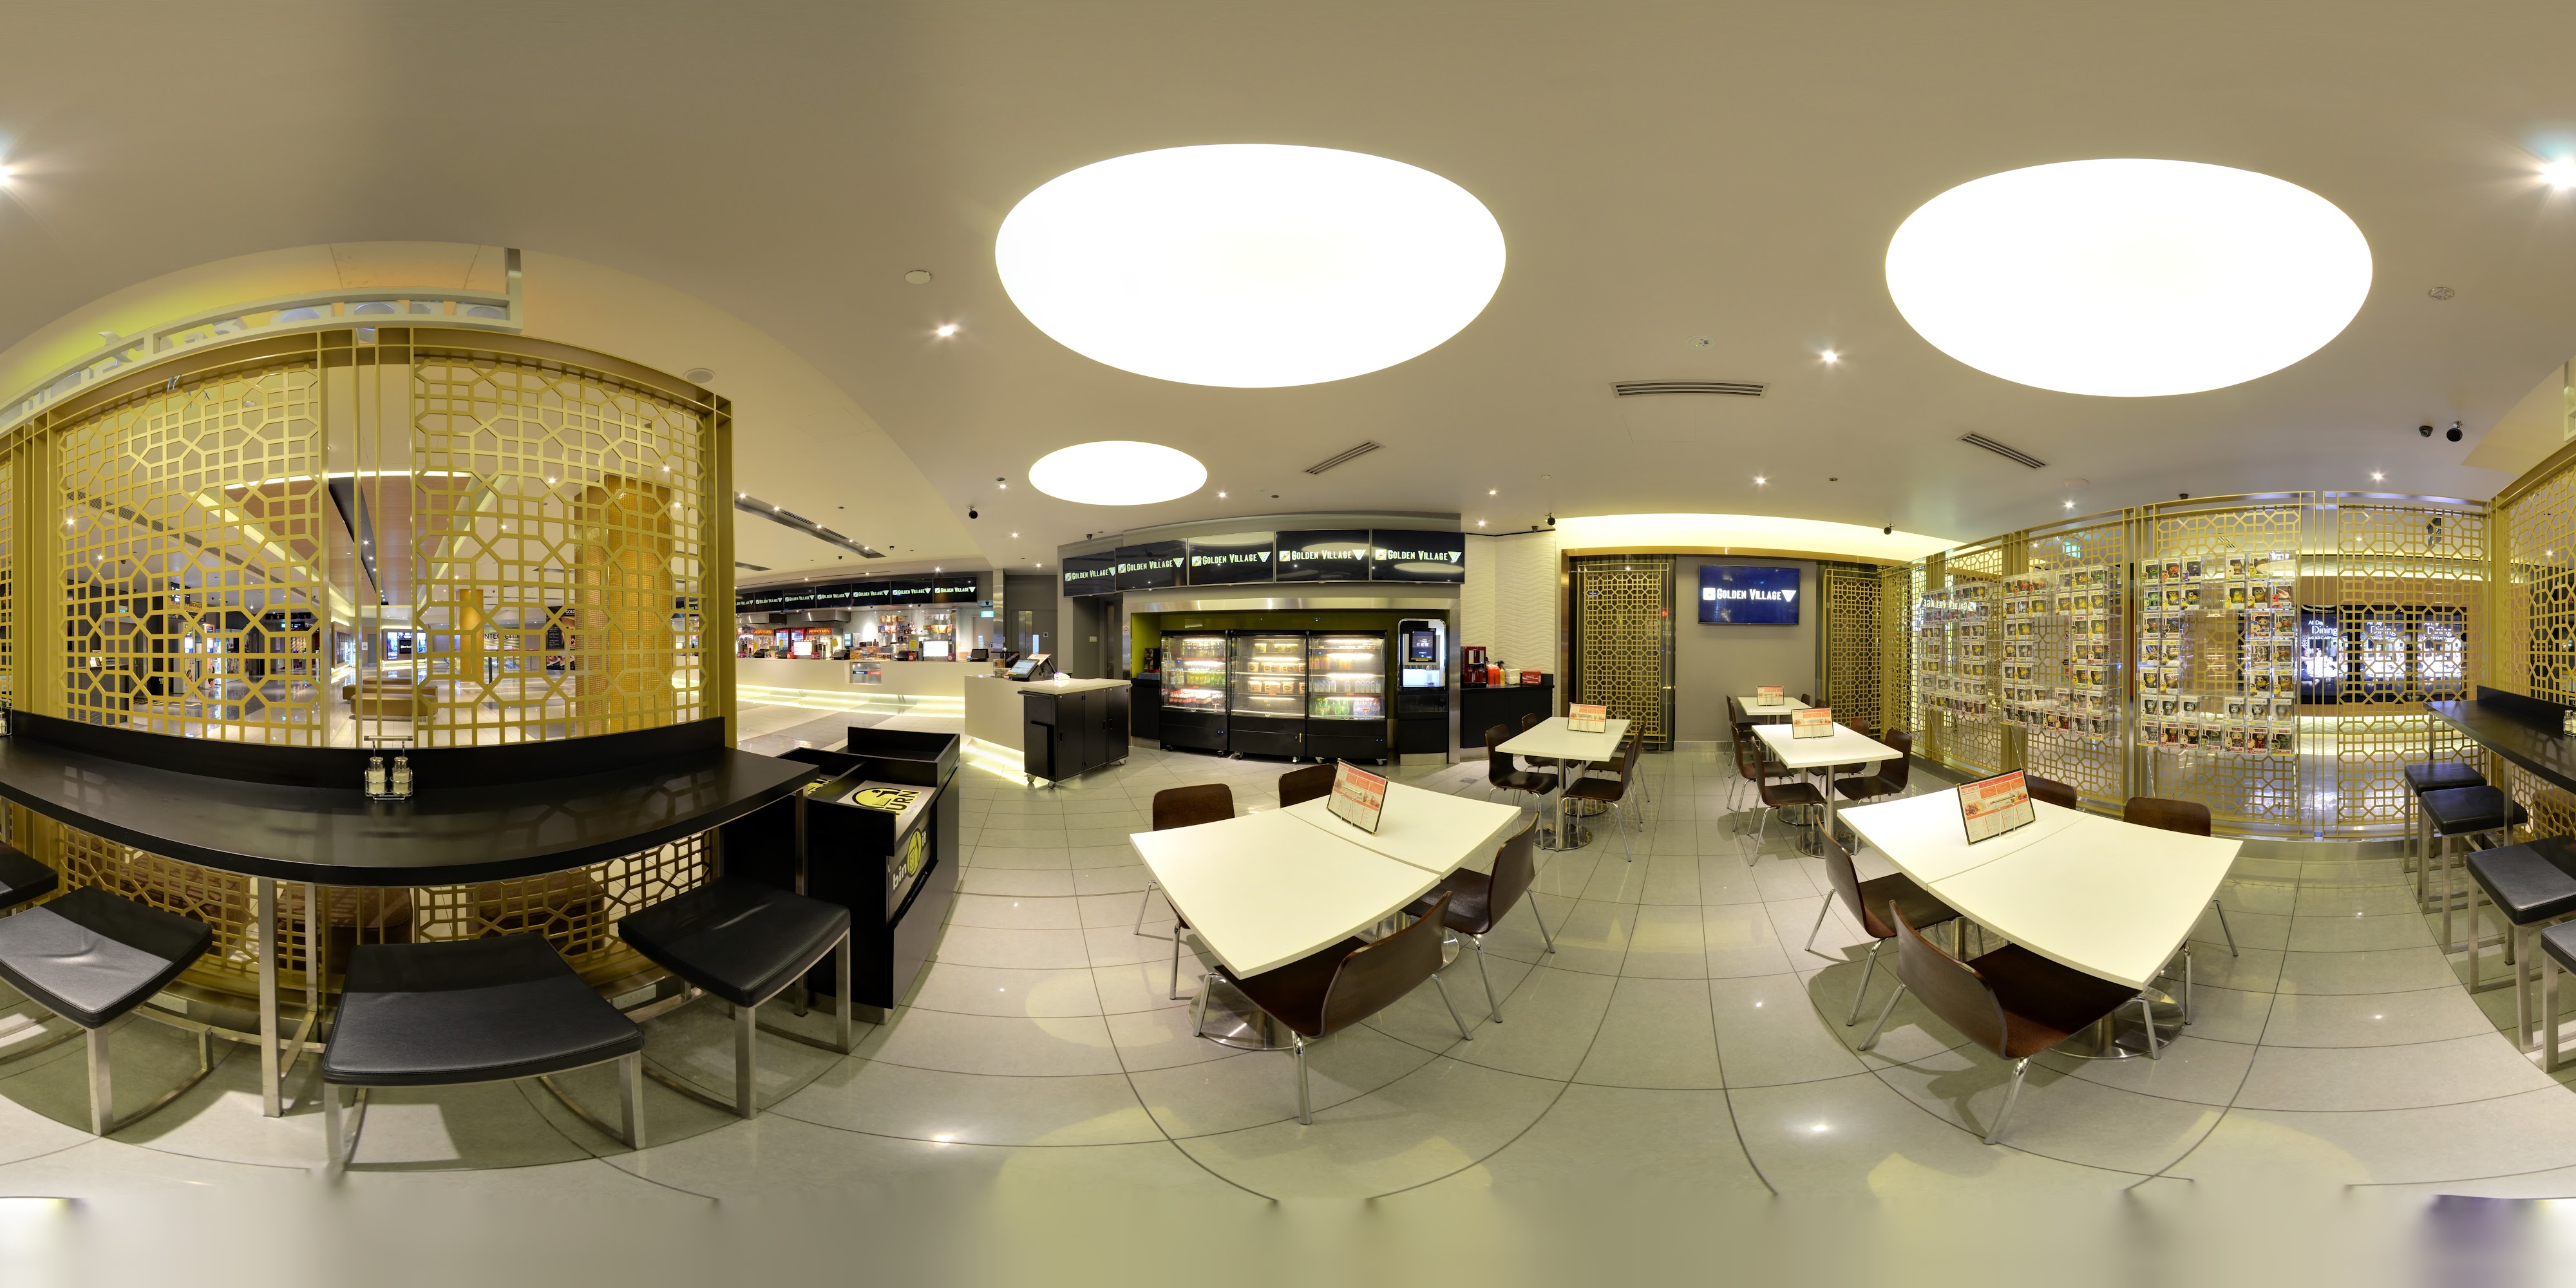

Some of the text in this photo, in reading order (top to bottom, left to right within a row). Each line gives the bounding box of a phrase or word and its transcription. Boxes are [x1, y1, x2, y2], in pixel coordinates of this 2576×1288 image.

[1202, 553, 1258, 565] GOLDEN VILLAGE
[1291, 550, 1352, 560] GOLDEN VILLAGE
[1388, 550, 1448, 561] GOLDEN VILLAGE
[1127, 560, 1173, 572] GOLDEN VILLAGE
[1072, 569, 1108, 580] GOLDEN VILLAGE
[1716, 588, 1782, 600] GOLDEN VILLAGE
[2312, 626, 2338, 636] Dining
[893, 831, 927, 890] bin it
